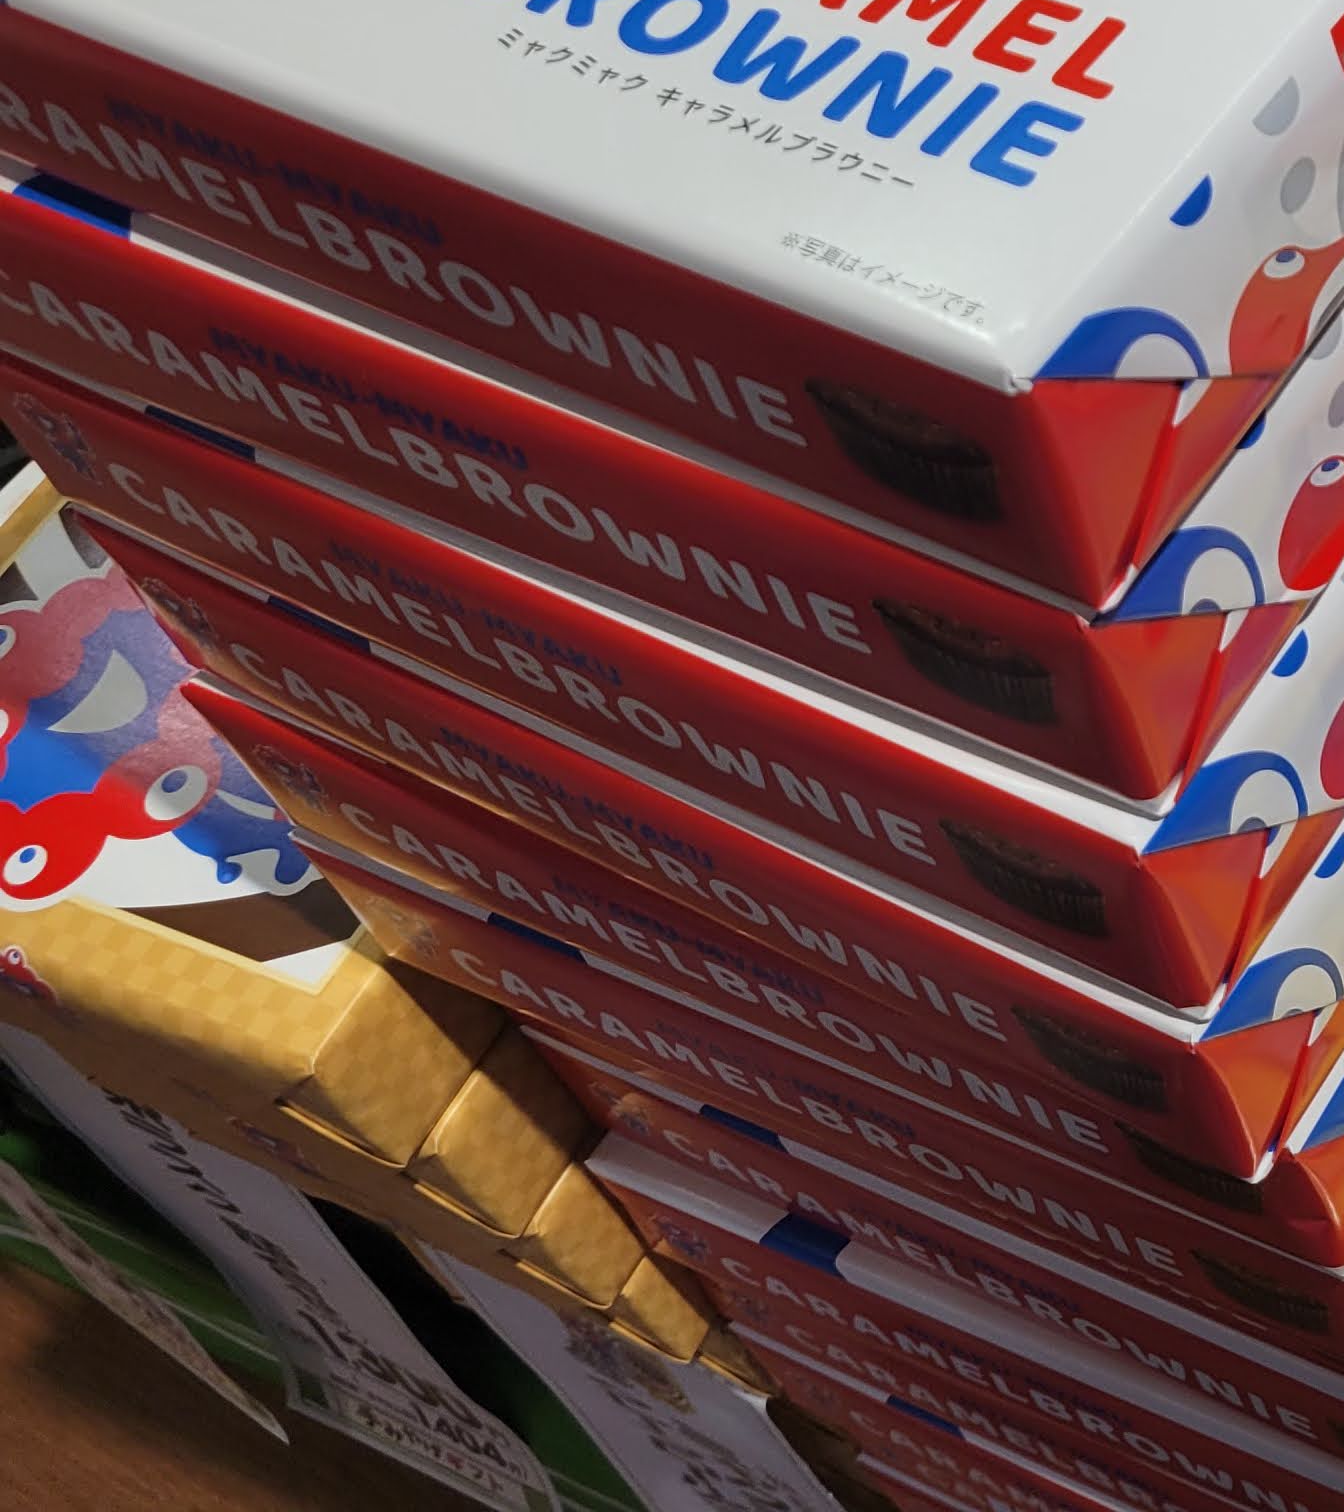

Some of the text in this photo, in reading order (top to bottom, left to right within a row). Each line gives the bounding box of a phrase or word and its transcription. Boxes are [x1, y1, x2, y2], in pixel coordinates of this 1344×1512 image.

[655, 85, 917, 189] キャラメルブラウニー
